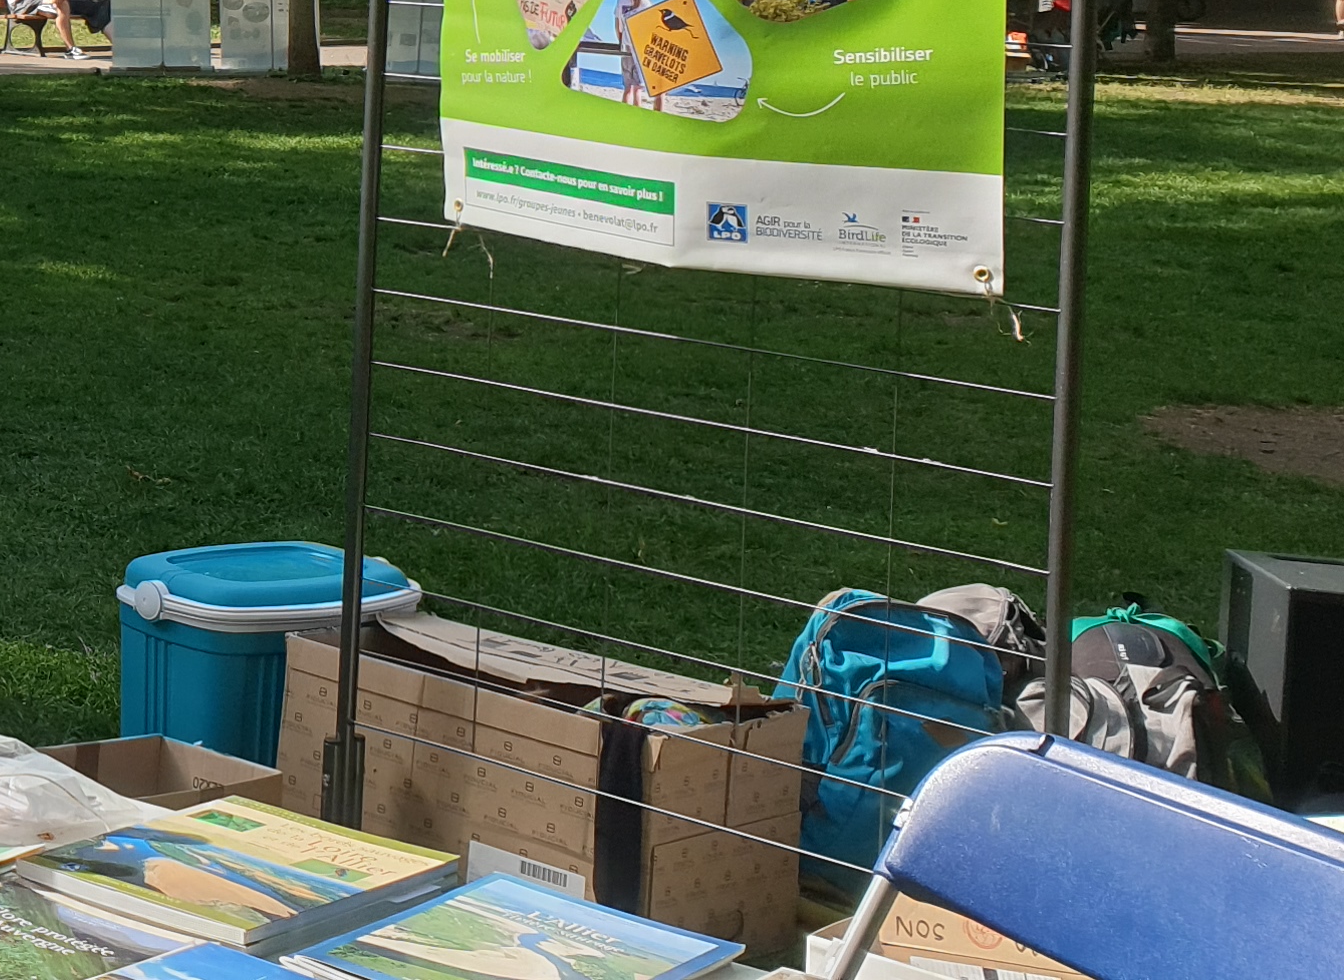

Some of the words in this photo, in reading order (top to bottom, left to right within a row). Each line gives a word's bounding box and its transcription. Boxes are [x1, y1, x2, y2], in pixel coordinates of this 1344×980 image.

[465, 48, 478, 62] Se
[481, 48, 526, 64] mobiliser
[650, 33, 689, 62] WARNING
[832, 46, 933, 65] Sensibiliser
[642, 57, 653, 71] EN
[651, 61, 679, 84] DANGER
[644, 45, 687, 75] GRAVELOTS
[462, 71, 484, 86] pour
[487, 71, 496, 85] la
[499, 72, 526, 85] nature
[849, 70, 864, 86] le
[869, 69, 918, 90] public
[578, 178, 597, 190] pour
[598, 182, 609, 192] en
[609, 182, 634, 196] savoir
[636, 187, 658, 201] plus
[582, 209, 658, 234] benevolat@lpo.fr
[756, 215, 780, 227] AGIR
[783, 218, 802, 229] pour
[803, 219, 811, 229] la
[714, 230, 742, 241] LPO
[756, 227, 823, 241] BIODIVERSITÉ
[838, 228, 886, 242] BirdLife
[308, 840, 379, 863] Loire
[526, 911, 622, 944] L'Allier
[895, 915, 946, 942] SON
[35, 924, 115, 959] protégée
